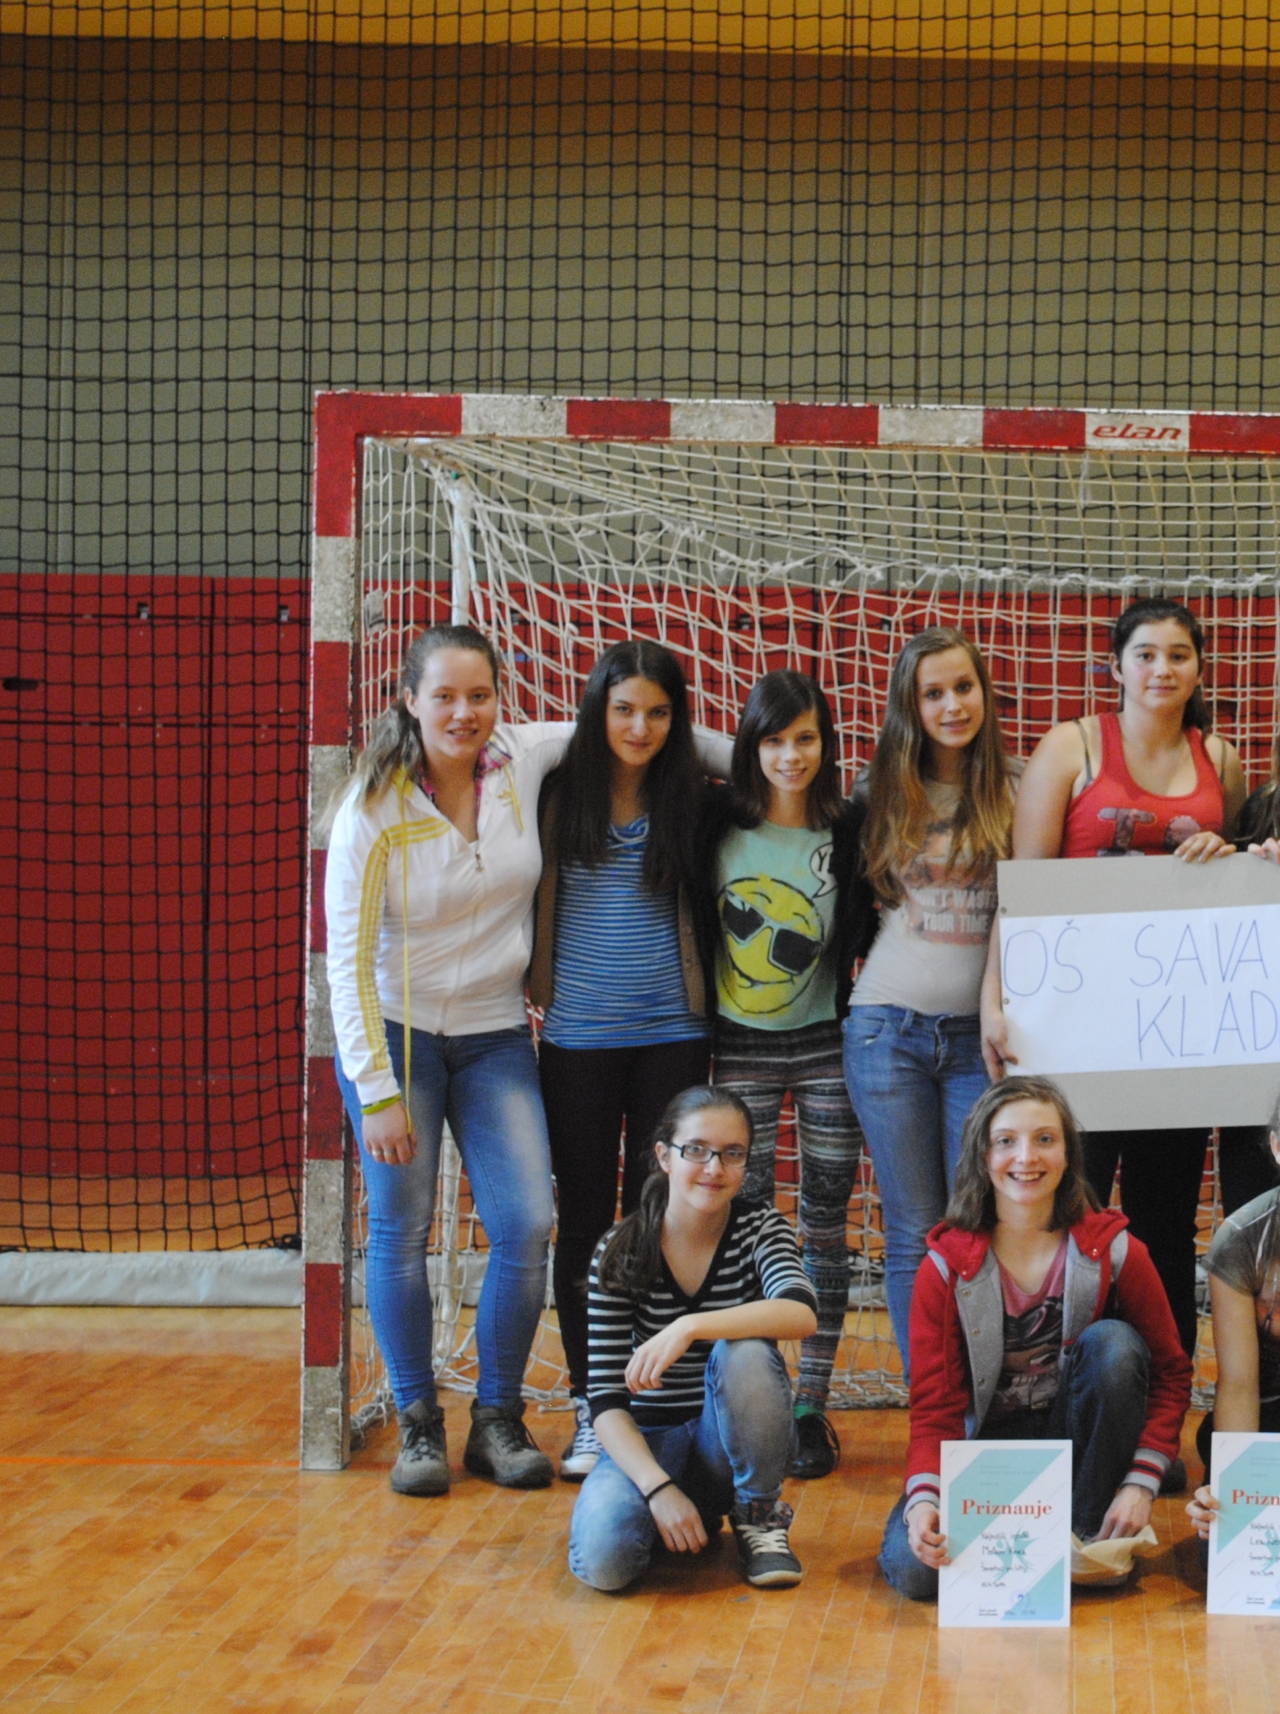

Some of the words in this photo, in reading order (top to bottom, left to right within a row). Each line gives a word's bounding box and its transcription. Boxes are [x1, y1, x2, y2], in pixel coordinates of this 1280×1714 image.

[1092, 422, 1182, 441] elan
[923, 911, 955, 933] YOUR
[958, 914, 989, 934] TIME
[1003, 918, 1084, 998] OŠ
[1129, 918, 1269, 989] SAVA
[961, 1499, 1053, 1519] Priznanje
